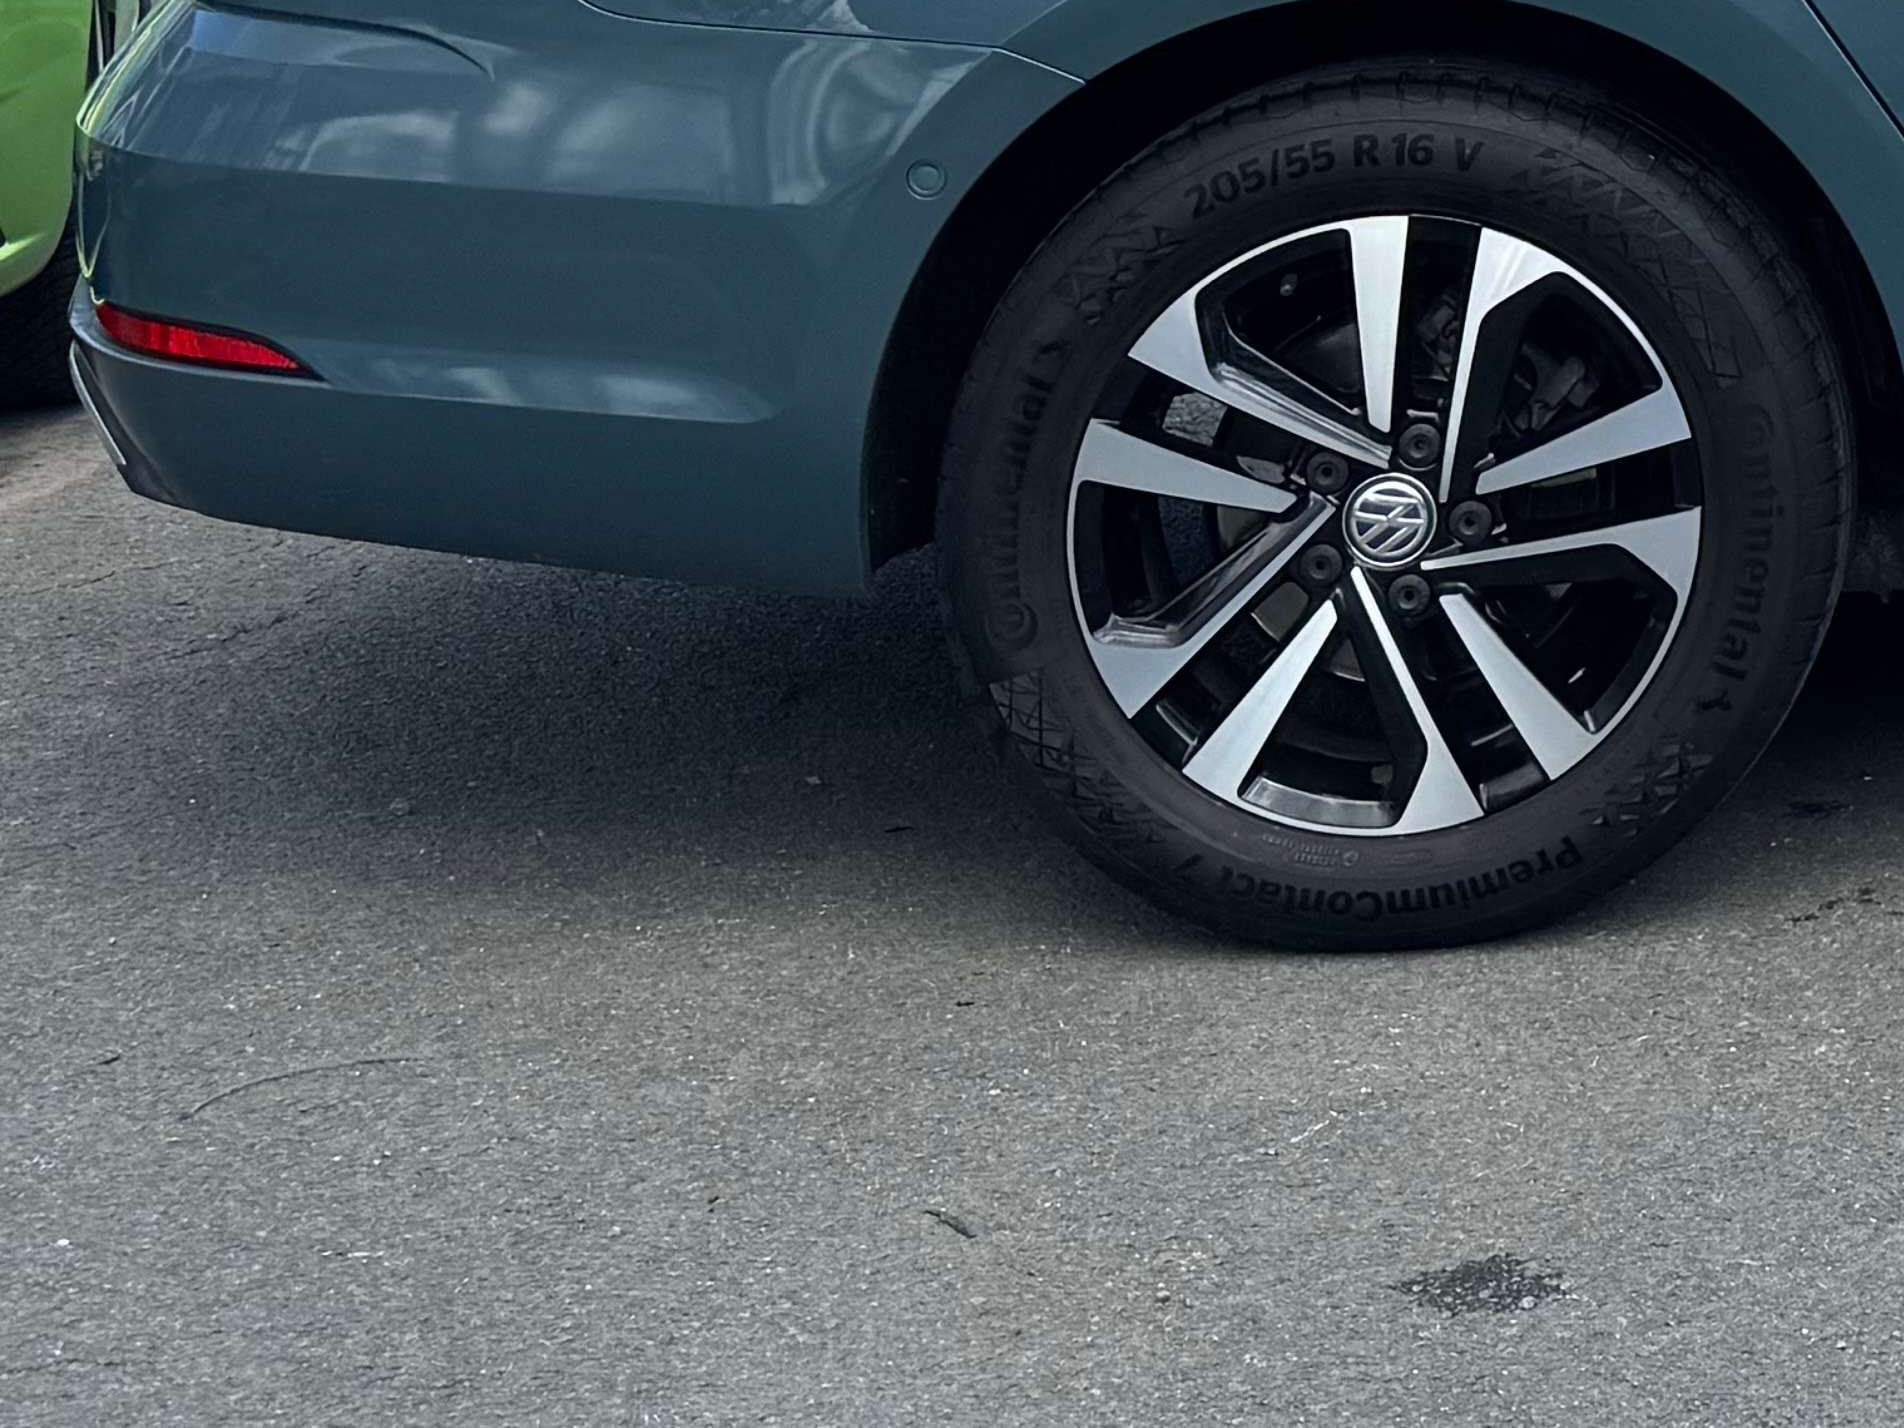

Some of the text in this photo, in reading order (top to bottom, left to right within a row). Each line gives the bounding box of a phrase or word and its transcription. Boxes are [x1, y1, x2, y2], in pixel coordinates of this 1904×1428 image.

[1183, 132, 1486, 219] 205/55 R 16 V
